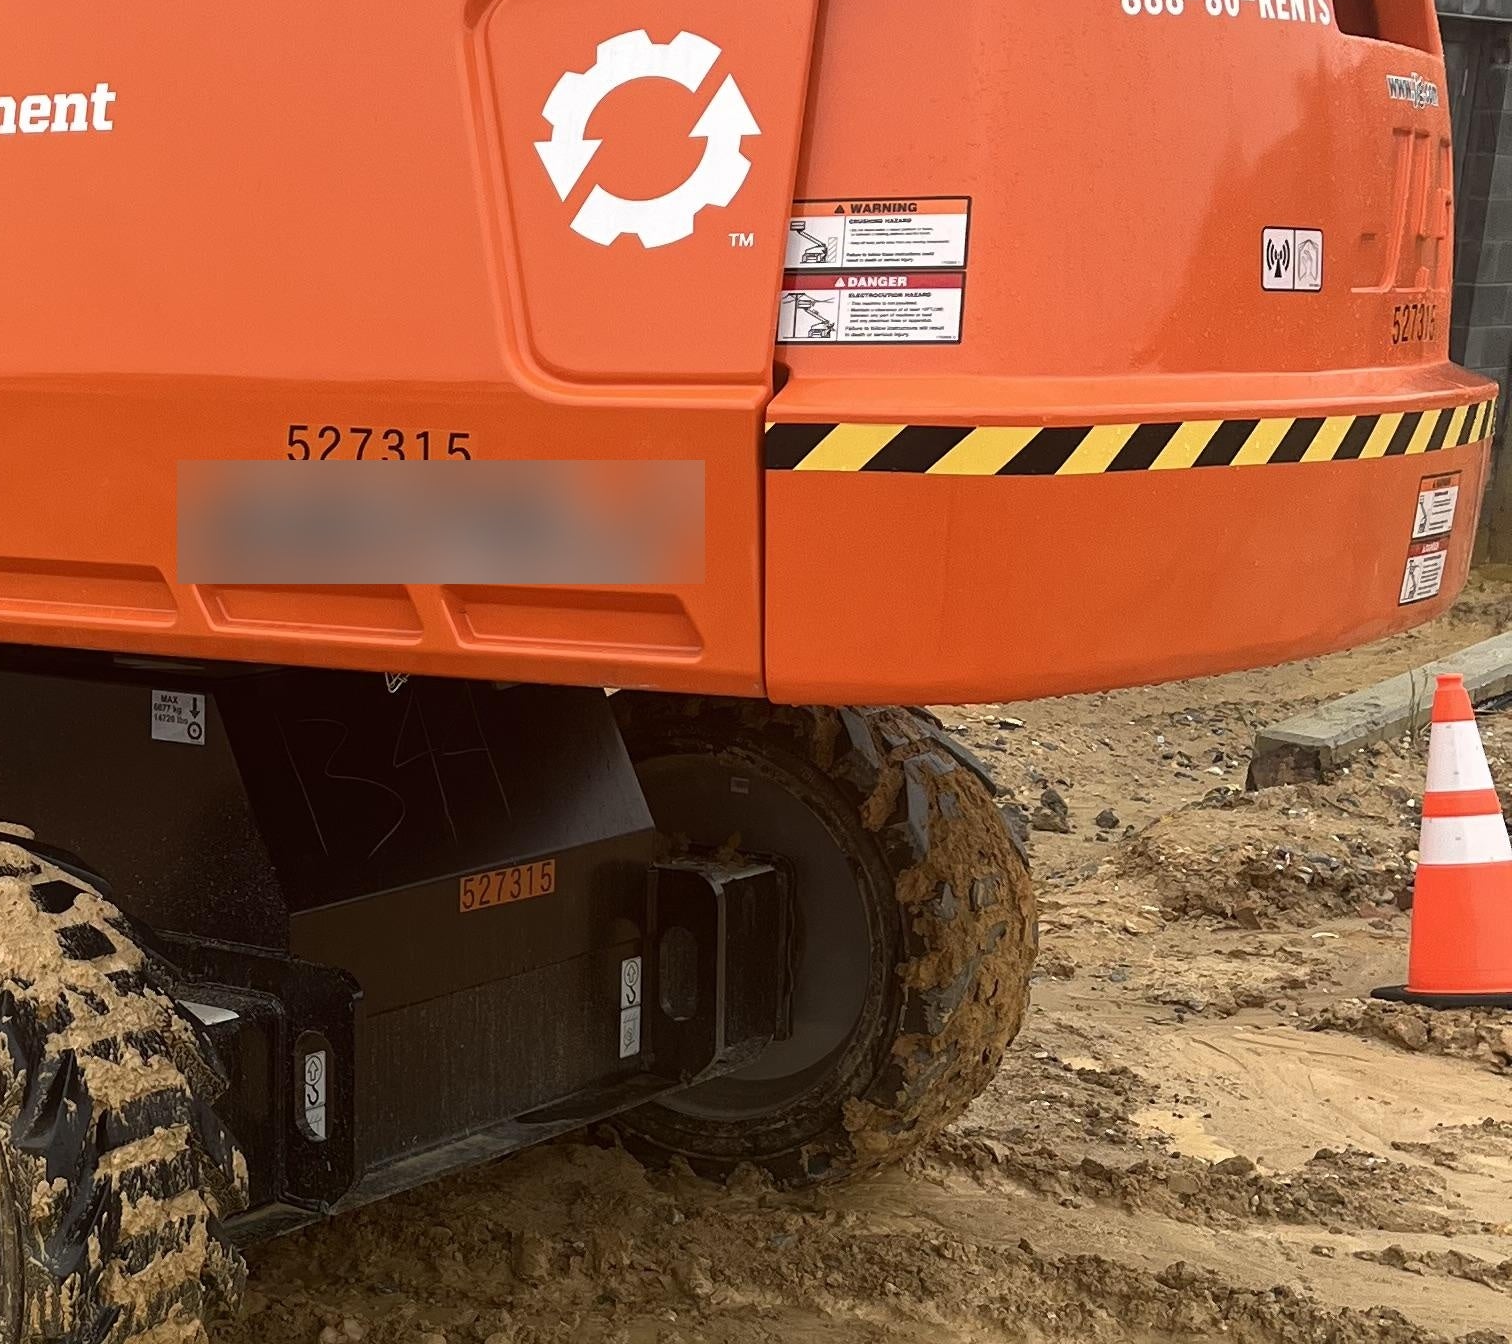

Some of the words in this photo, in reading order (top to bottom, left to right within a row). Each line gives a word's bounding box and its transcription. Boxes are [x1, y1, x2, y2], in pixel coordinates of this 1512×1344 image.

[849, 202, 918, 214] WARNING
[847, 276, 908, 288] DANGER
[1391, 304, 1438, 345] 527315
[287, 424, 472, 461] 527315
[160, 694, 179, 704] MAX
[462, 860, 554, 911] 527315
